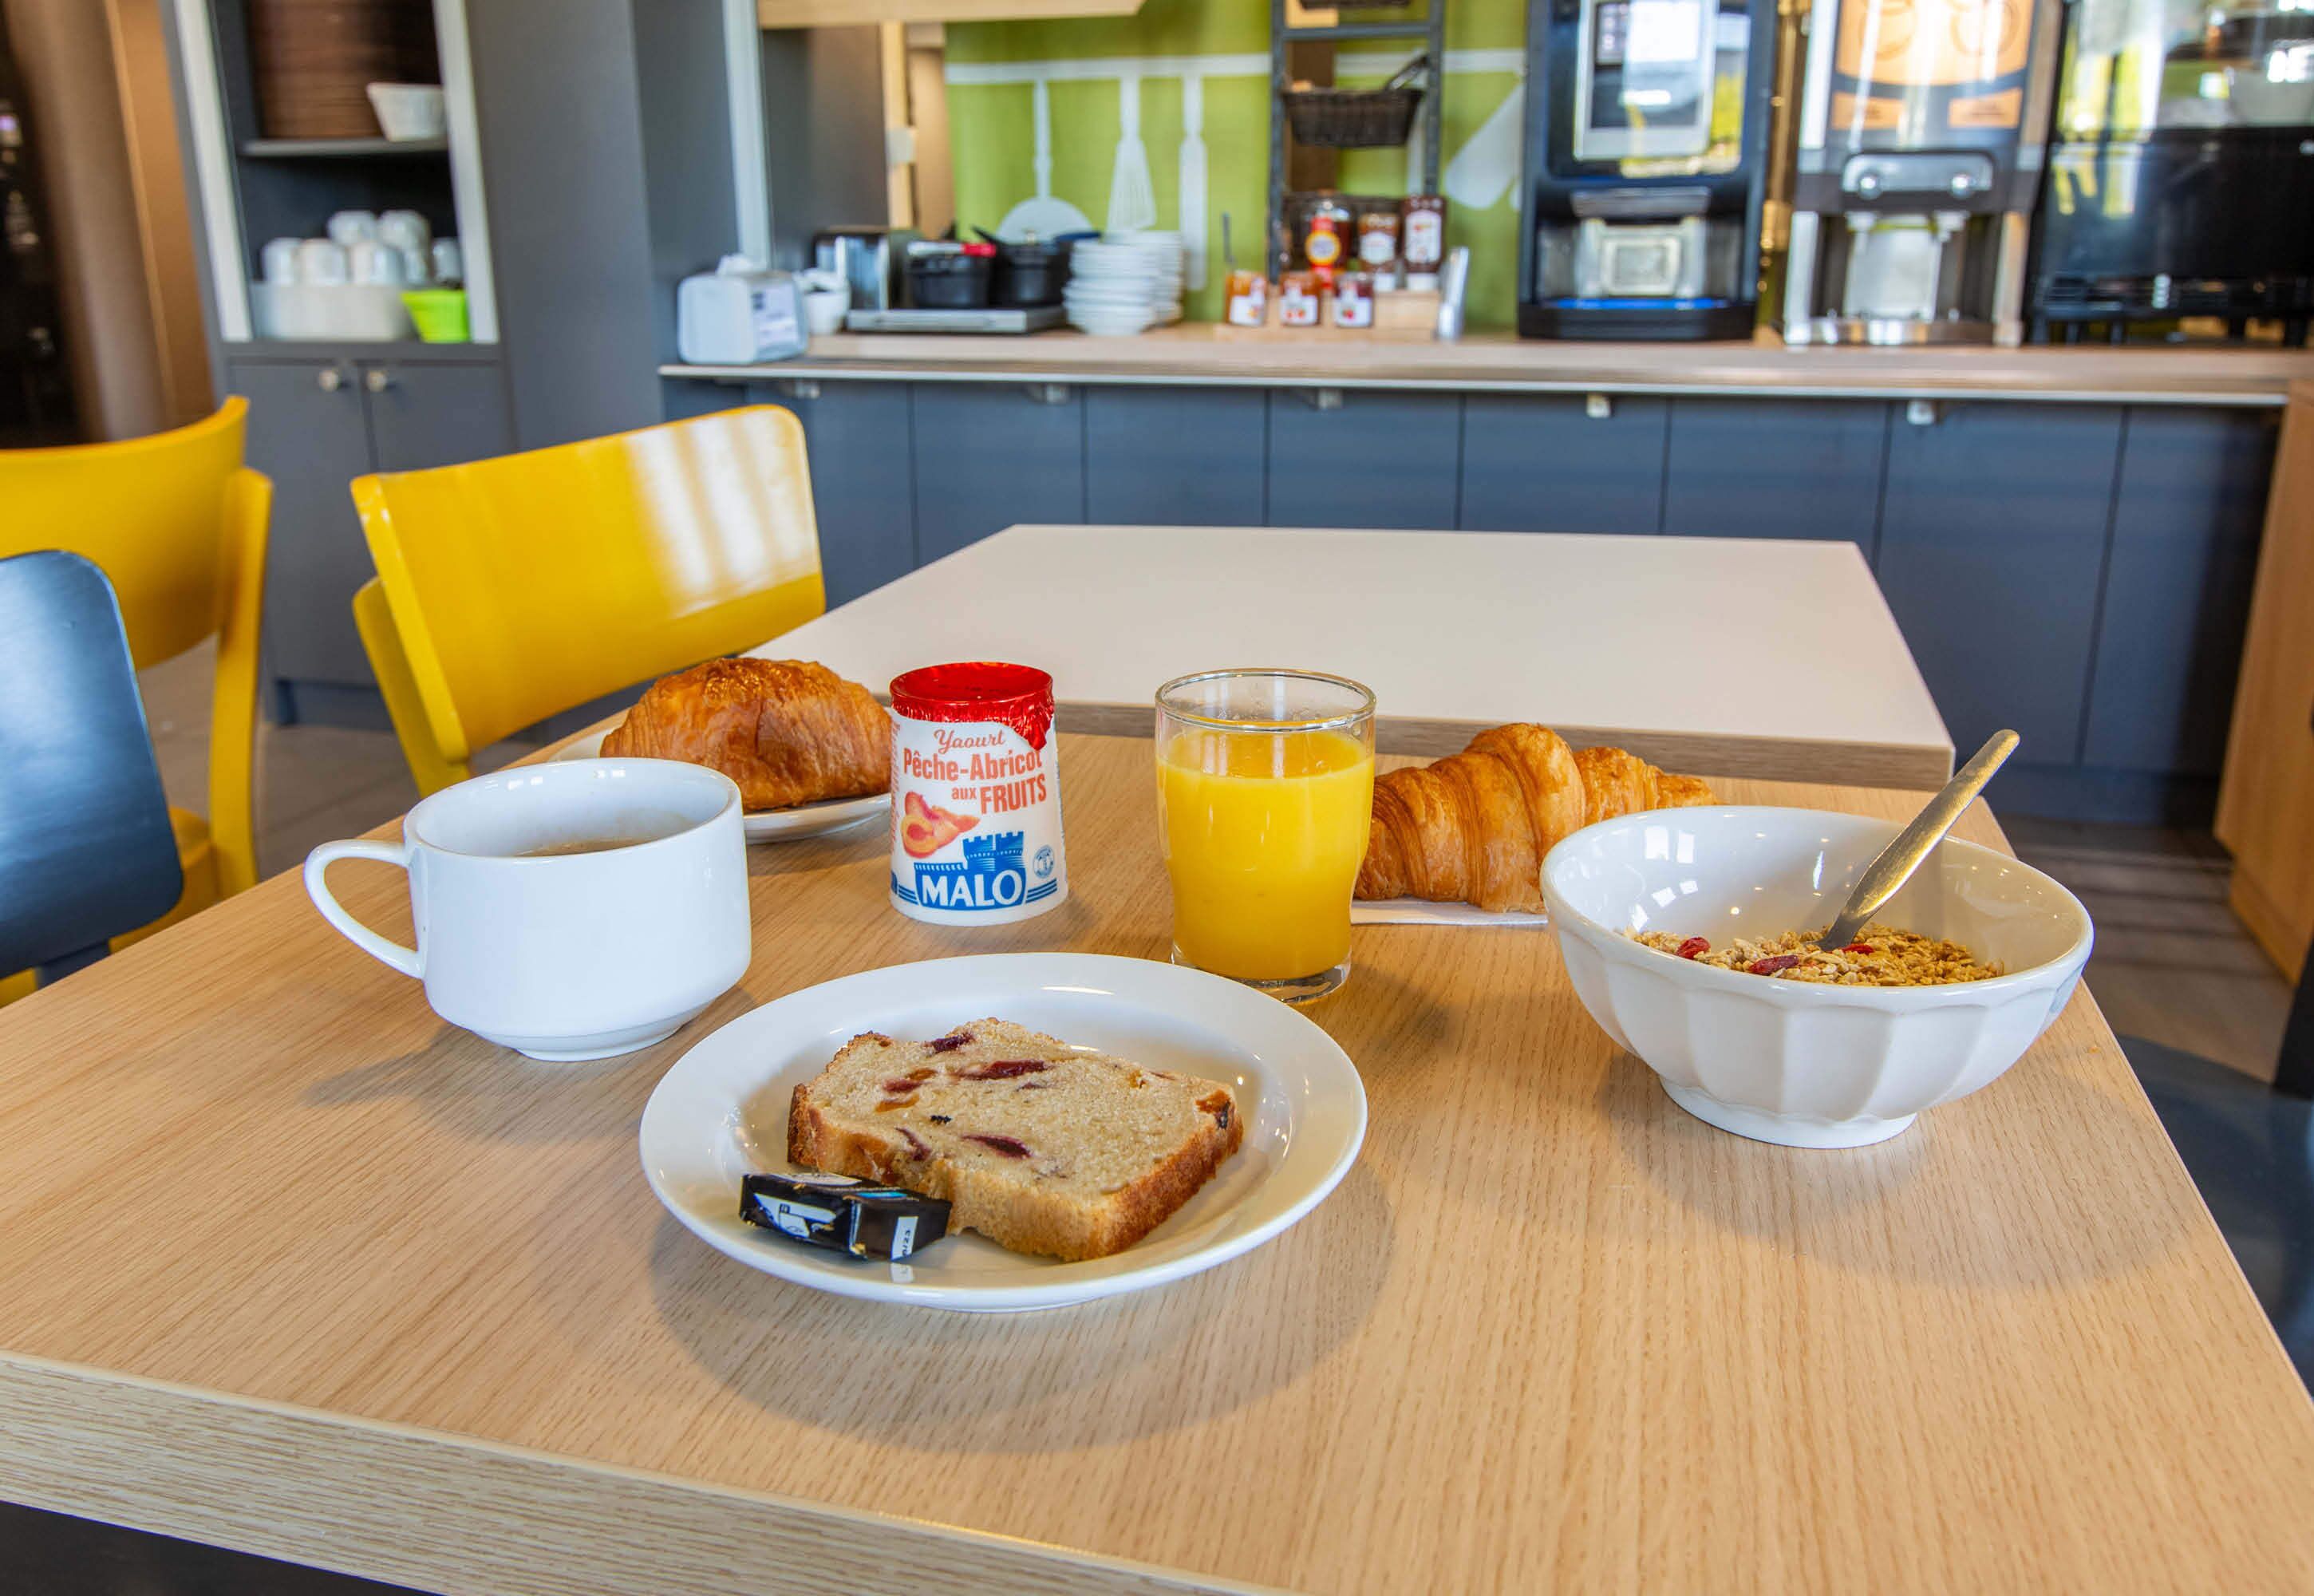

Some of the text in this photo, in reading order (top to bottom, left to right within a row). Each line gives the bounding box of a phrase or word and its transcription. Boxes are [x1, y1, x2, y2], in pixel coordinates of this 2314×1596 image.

[934, 729, 1006, 754] Yaourt
[903, 748, 1042, 781] Pêche-Abricot
[951, 773, 1047, 815] aux FRUITS
[922, 870, 1023, 907] MALO
